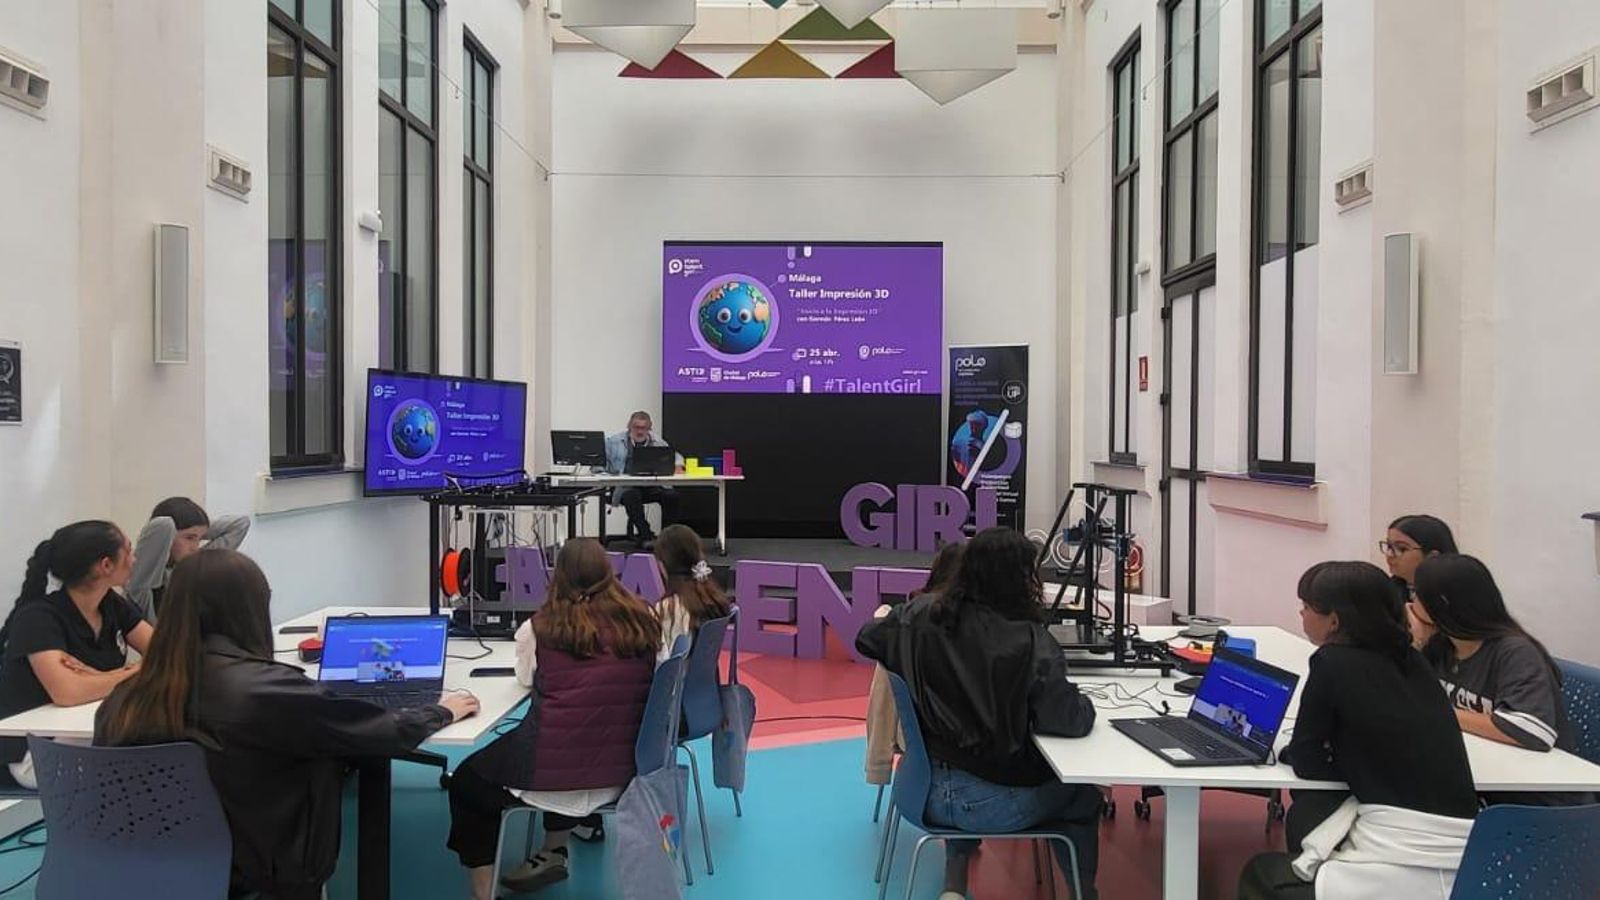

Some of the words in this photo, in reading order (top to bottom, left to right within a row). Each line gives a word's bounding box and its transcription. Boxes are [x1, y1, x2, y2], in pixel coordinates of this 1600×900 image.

[788, 273, 822, 284] Málaga
[788, 289, 818, 299] Taller
[820, 288, 872, 301] Impresión
[875, 289, 890, 299] 3D
[809, 348, 821, 357] 25
[822, 347, 841, 357] abr.
[955, 354, 987, 372] polo
[824, 378, 922, 394] #TalentGirl
